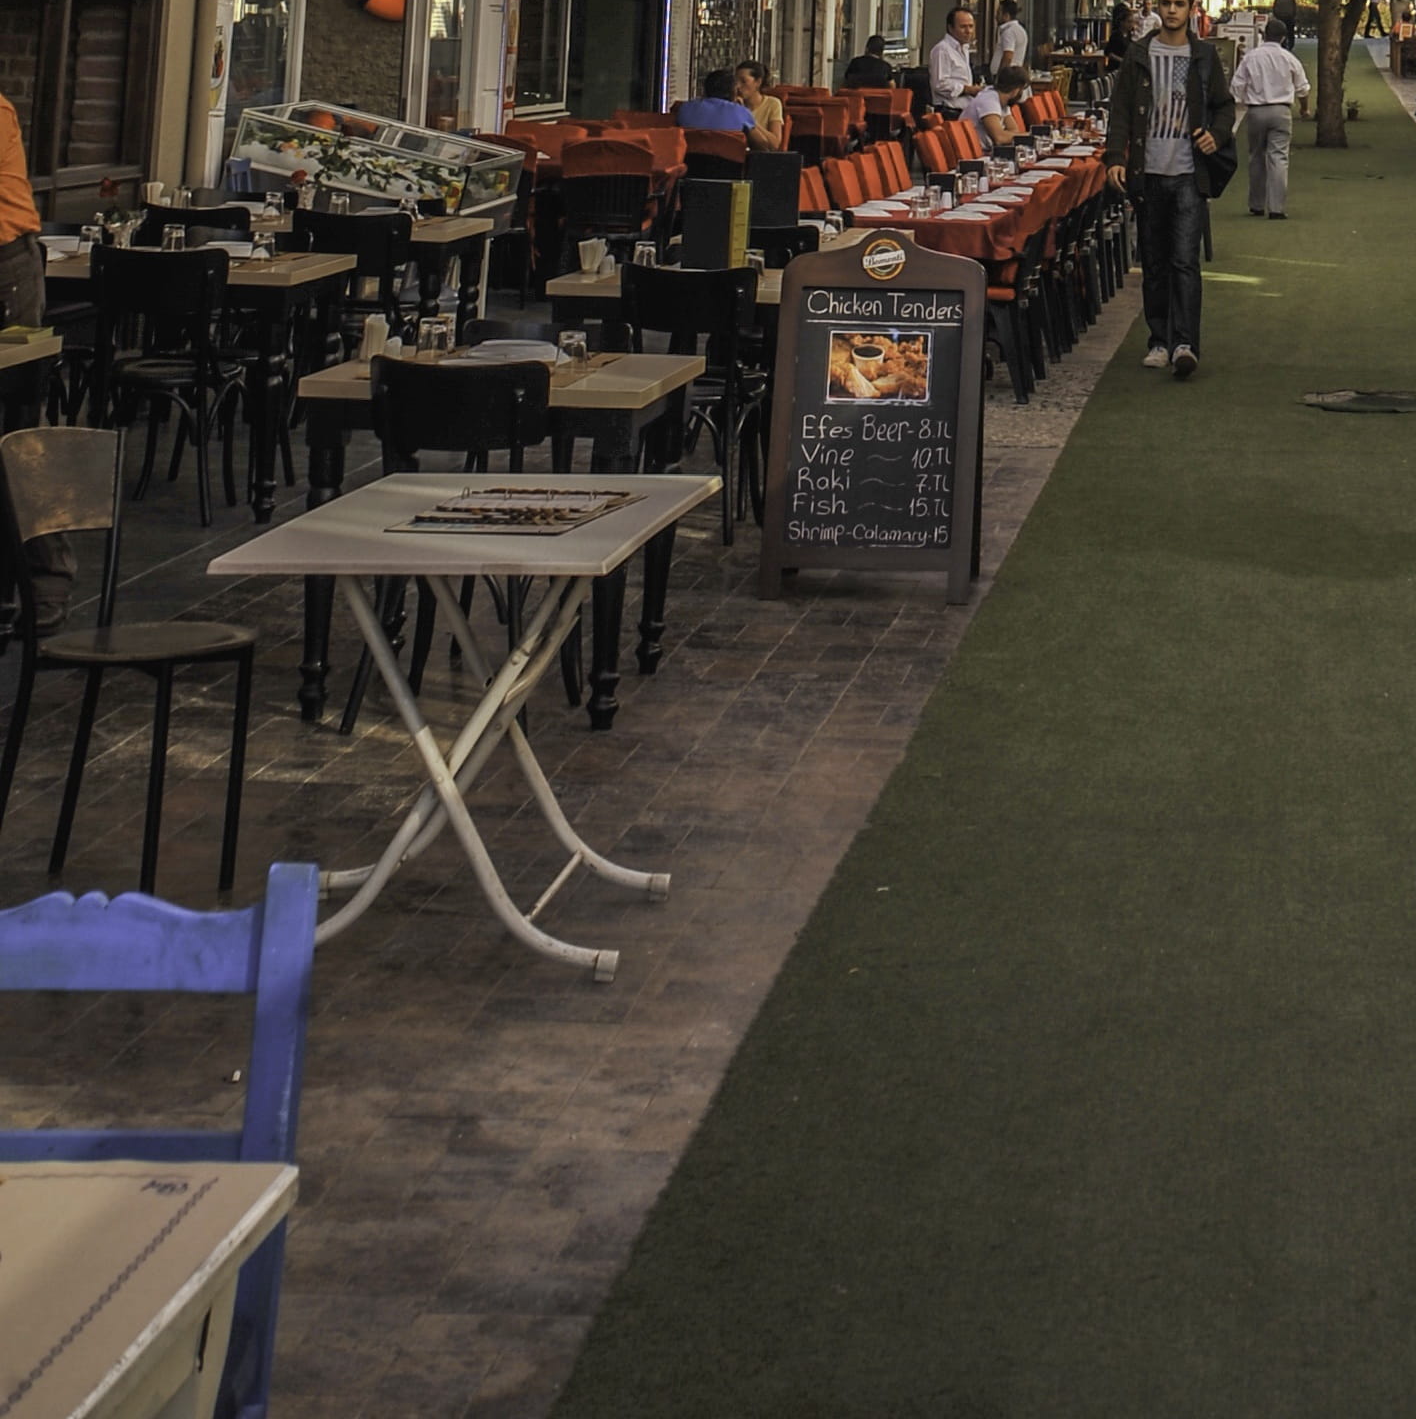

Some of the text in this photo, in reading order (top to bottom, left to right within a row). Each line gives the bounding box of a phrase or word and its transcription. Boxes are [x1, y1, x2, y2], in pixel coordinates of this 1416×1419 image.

[807, 290, 963, 320] Chicken Tenders
[802, 414, 853, 439] Efes
[801, 442, 854, 465] Vine
[797, 467, 850, 492] Raki
[792, 492, 849, 515] Fish
